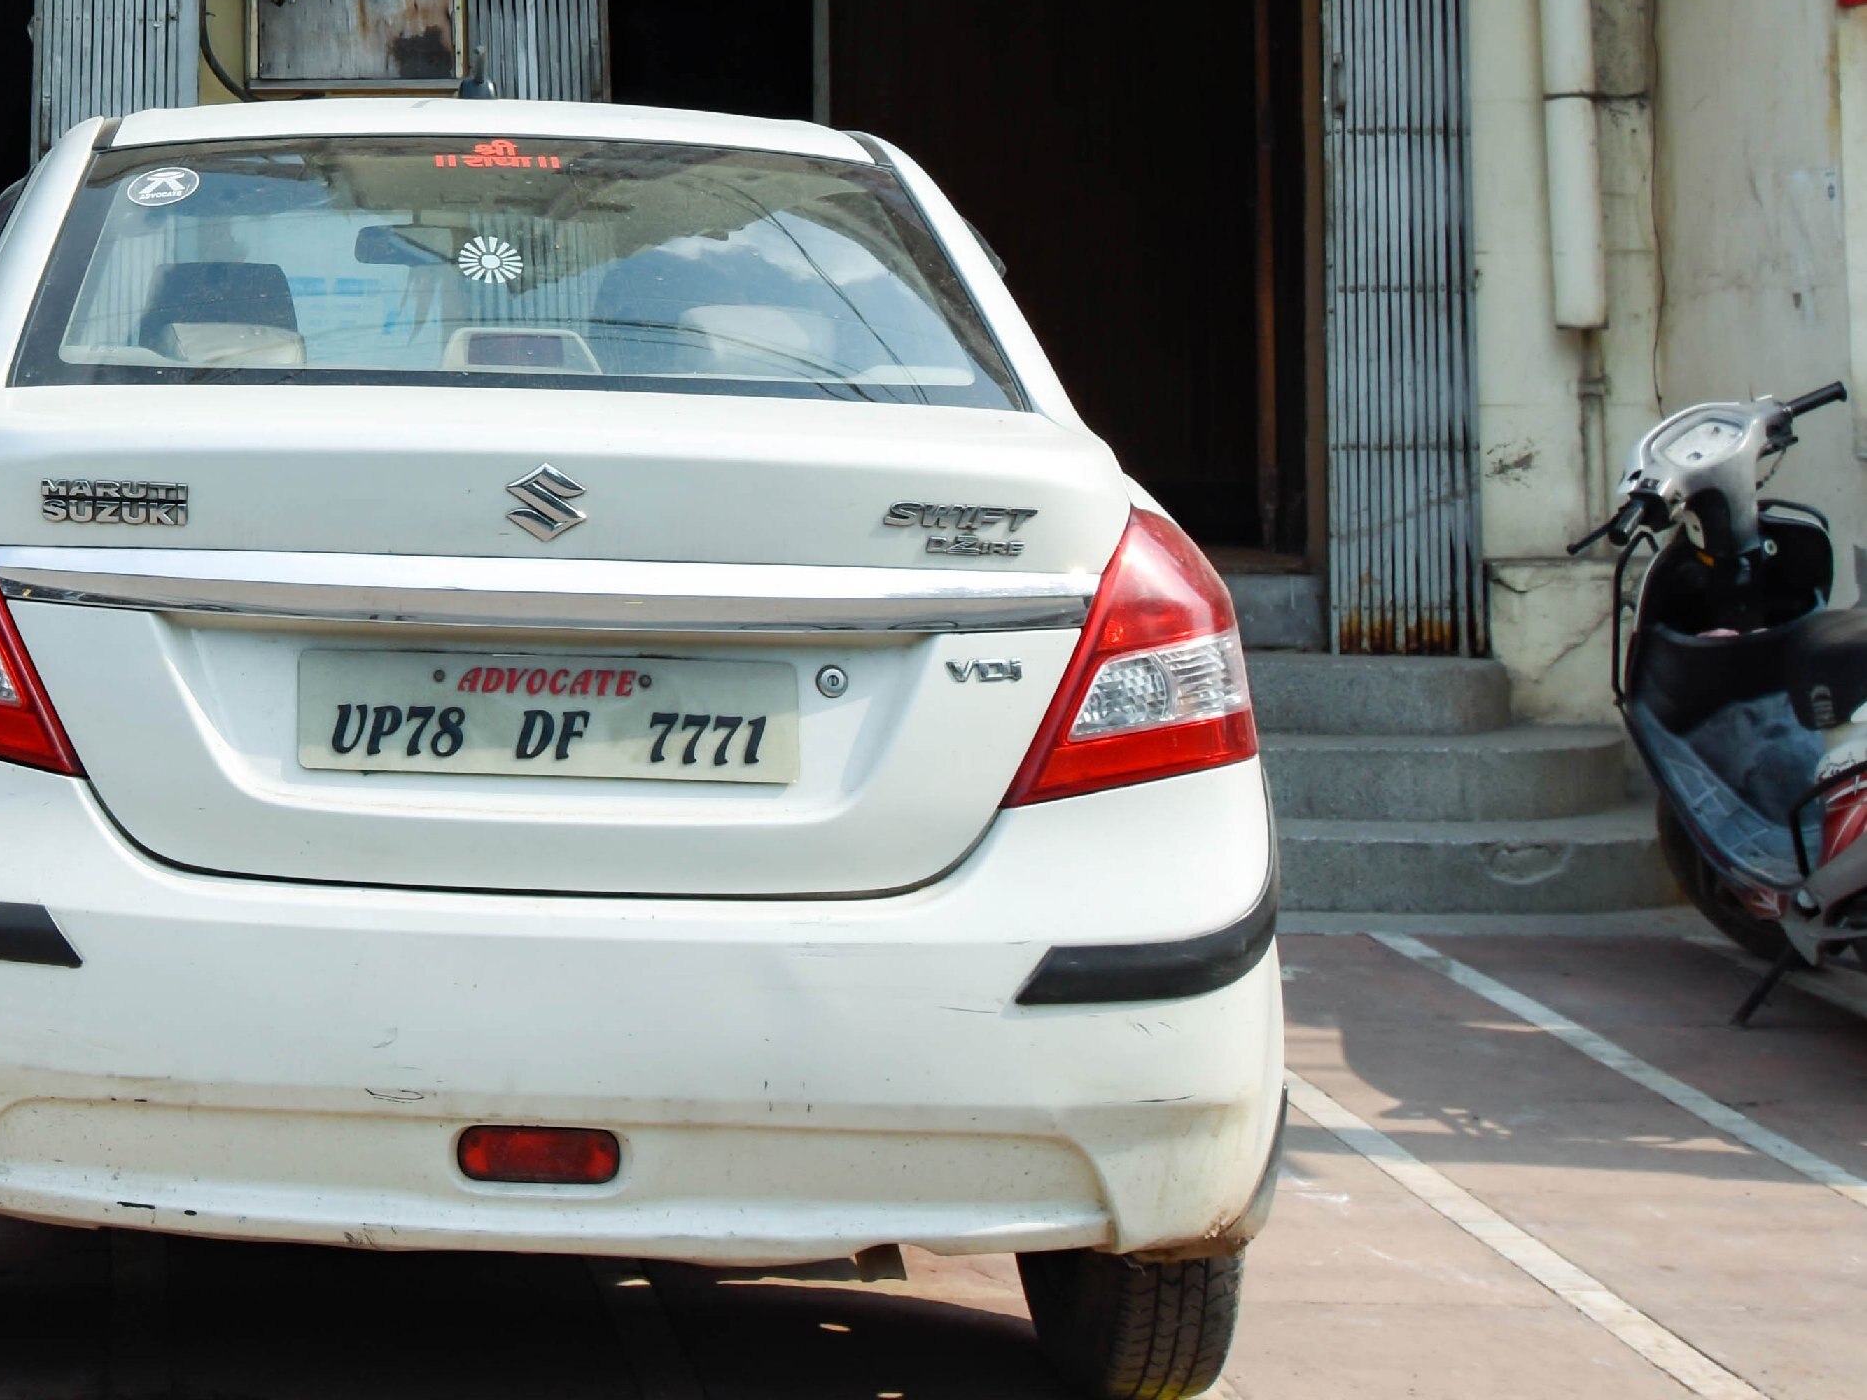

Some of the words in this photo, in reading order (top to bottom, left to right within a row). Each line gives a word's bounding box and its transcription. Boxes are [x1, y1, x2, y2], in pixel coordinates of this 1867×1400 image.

[40, 477, 189, 501] MARUTI
[41, 499, 189, 527] SUZUKI
[883, 501, 1038, 532] SWIFT
[457, 666, 637, 697] ADVOCATE
[332, 703, 467, 758] UP78
[515, 709, 591, 761] DF
[648, 712, 767, 767] 7771
